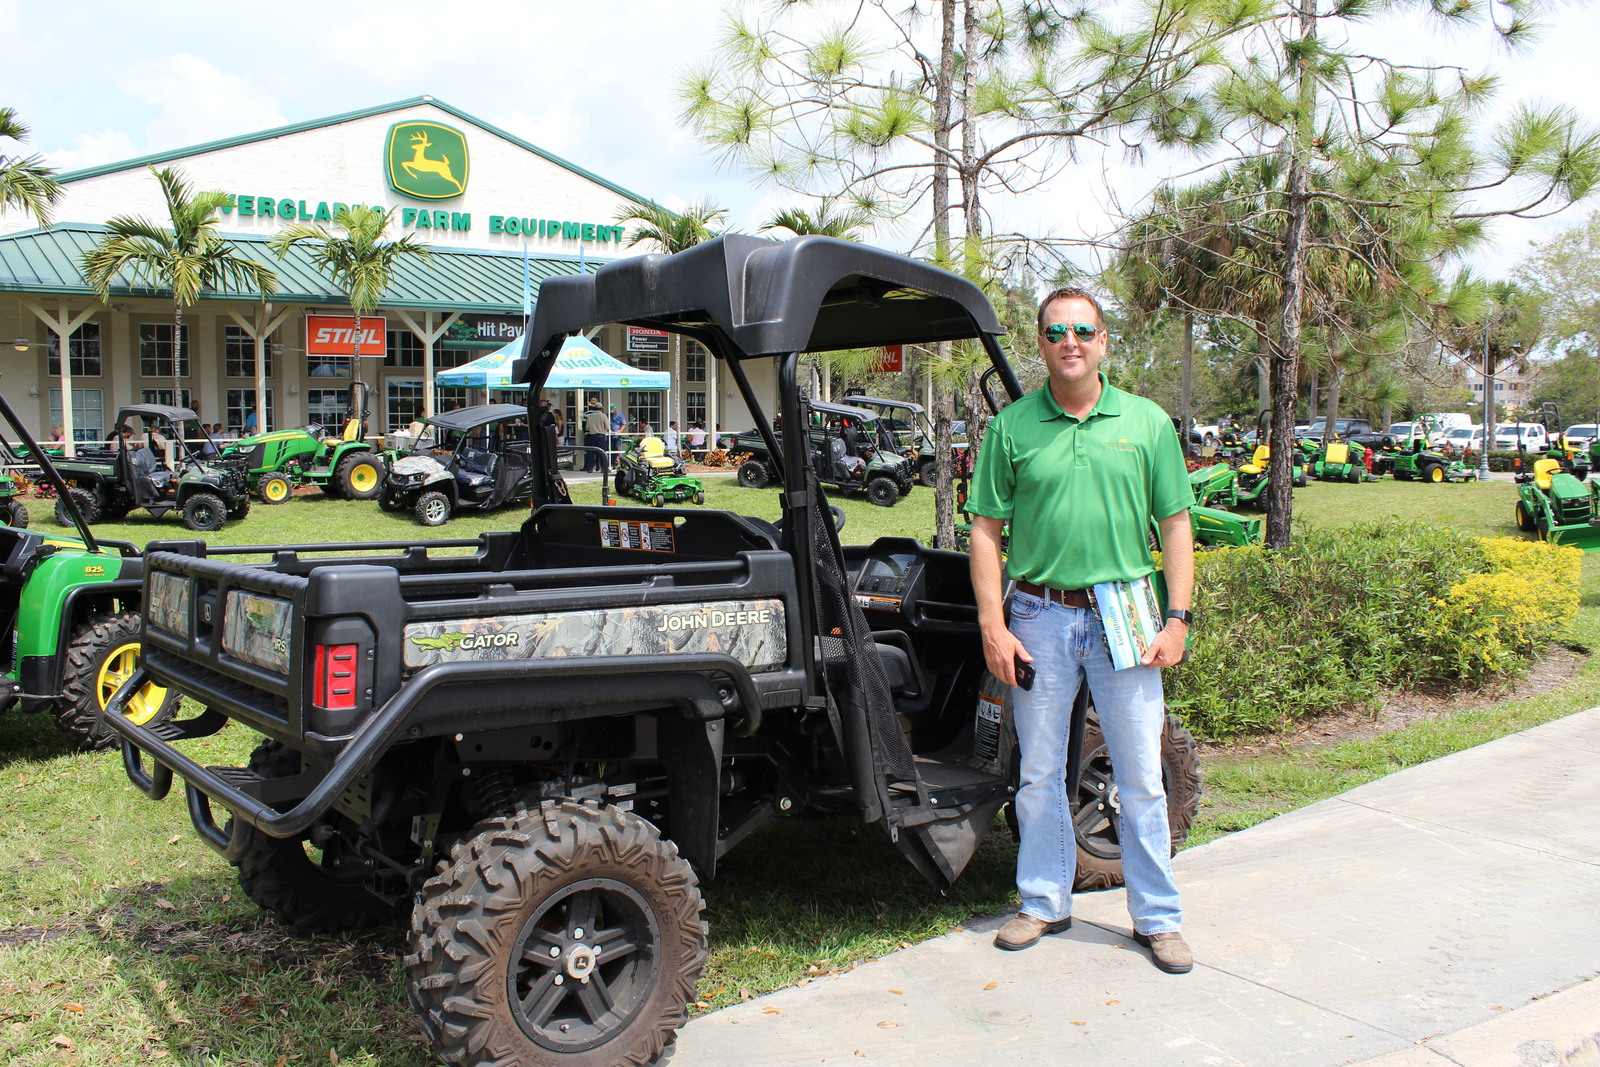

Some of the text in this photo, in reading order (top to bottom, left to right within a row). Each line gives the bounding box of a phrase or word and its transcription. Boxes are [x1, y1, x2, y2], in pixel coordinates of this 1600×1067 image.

[402, 207, 472, 231] FARM
[489, 215, 626, 243] EQUIPMENT
[314, 327, 381, 345] STIHL
[477, 321, 496, 337] Hit
[657, 609, 771, 632] JOHN DEERE
[459, 632, 519, 650] GATOR
